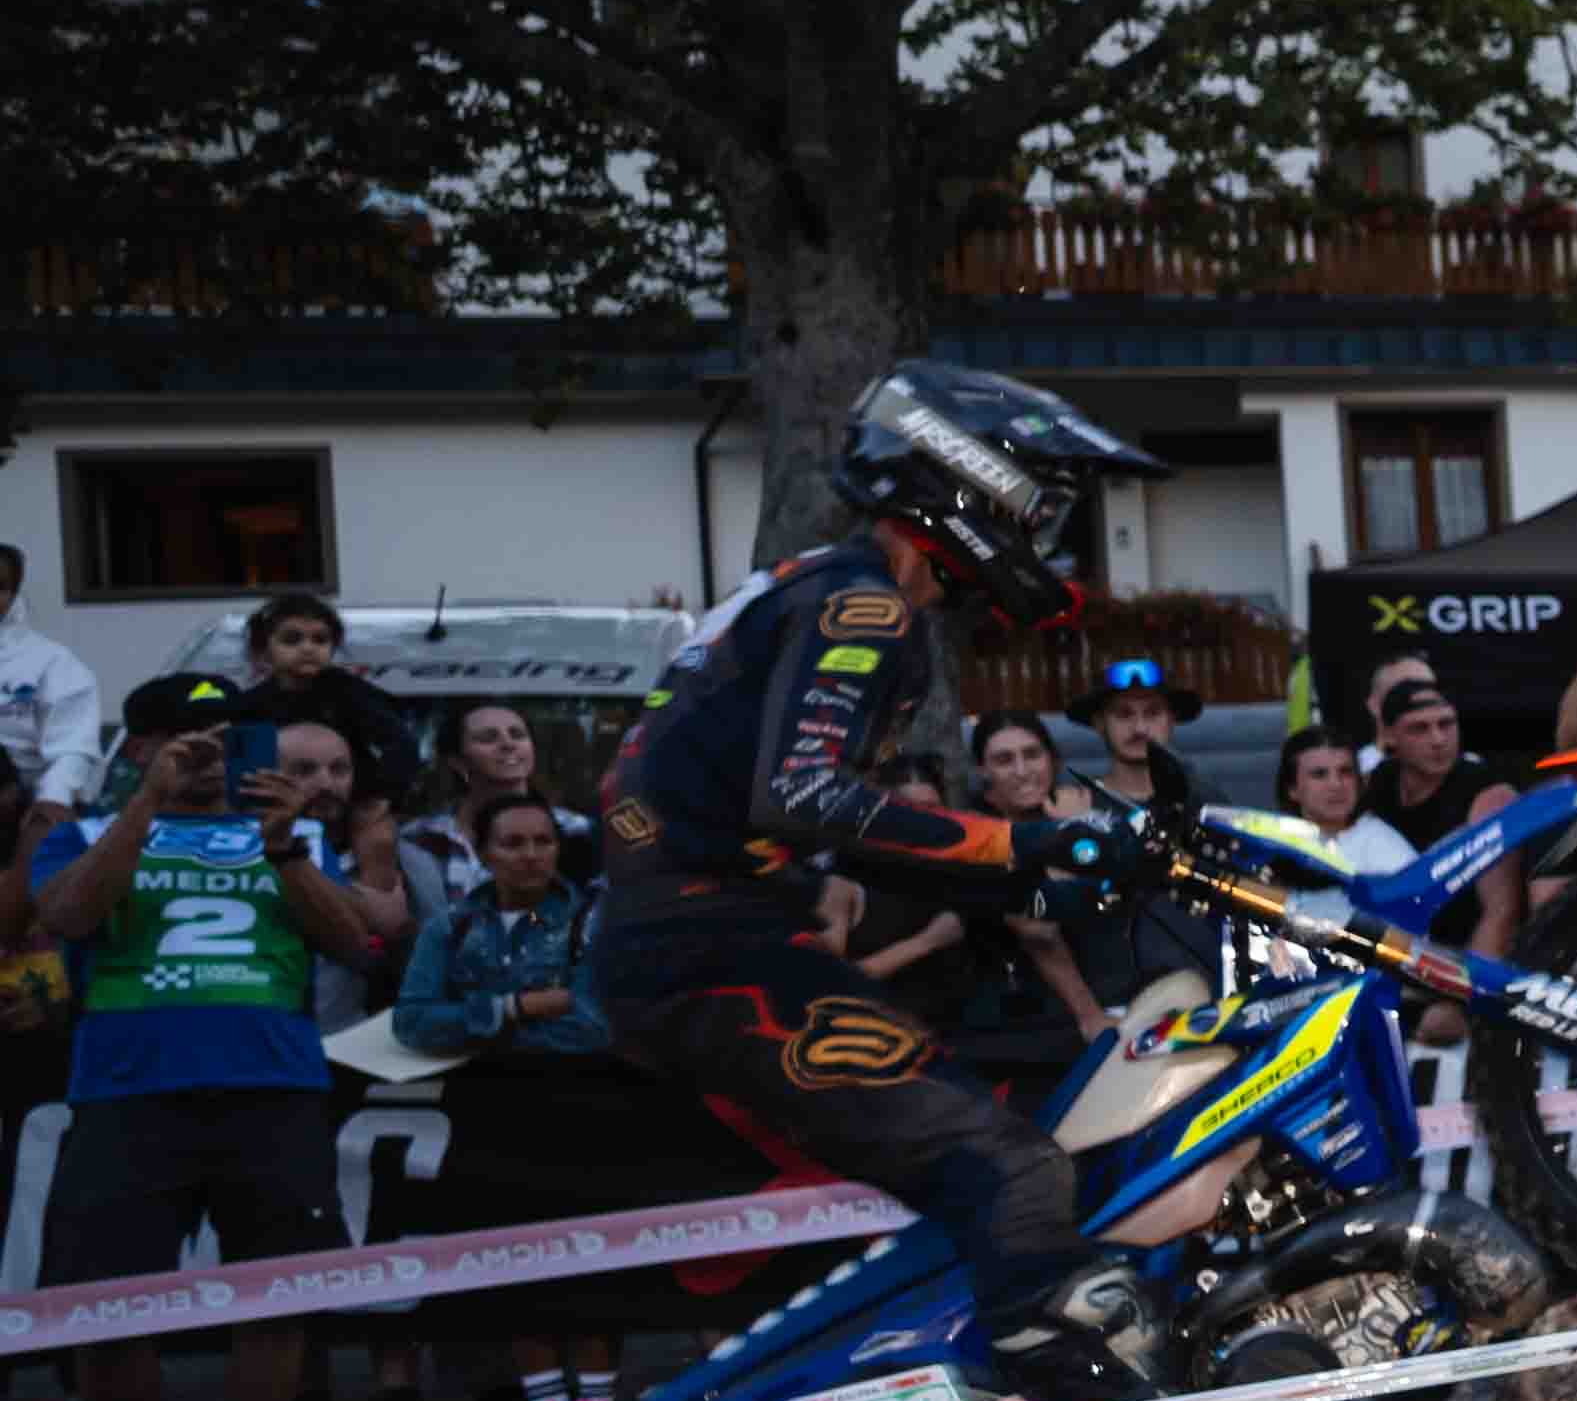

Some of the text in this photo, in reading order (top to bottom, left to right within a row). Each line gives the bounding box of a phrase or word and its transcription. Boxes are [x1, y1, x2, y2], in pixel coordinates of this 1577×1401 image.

[1369, 594, 1562, 634] X-GRIP
[133, 869, 279, 896] MEDIA
[156, 897, 257, 955] 2
[1200, 1047, 1316, 1130] SHERCO
